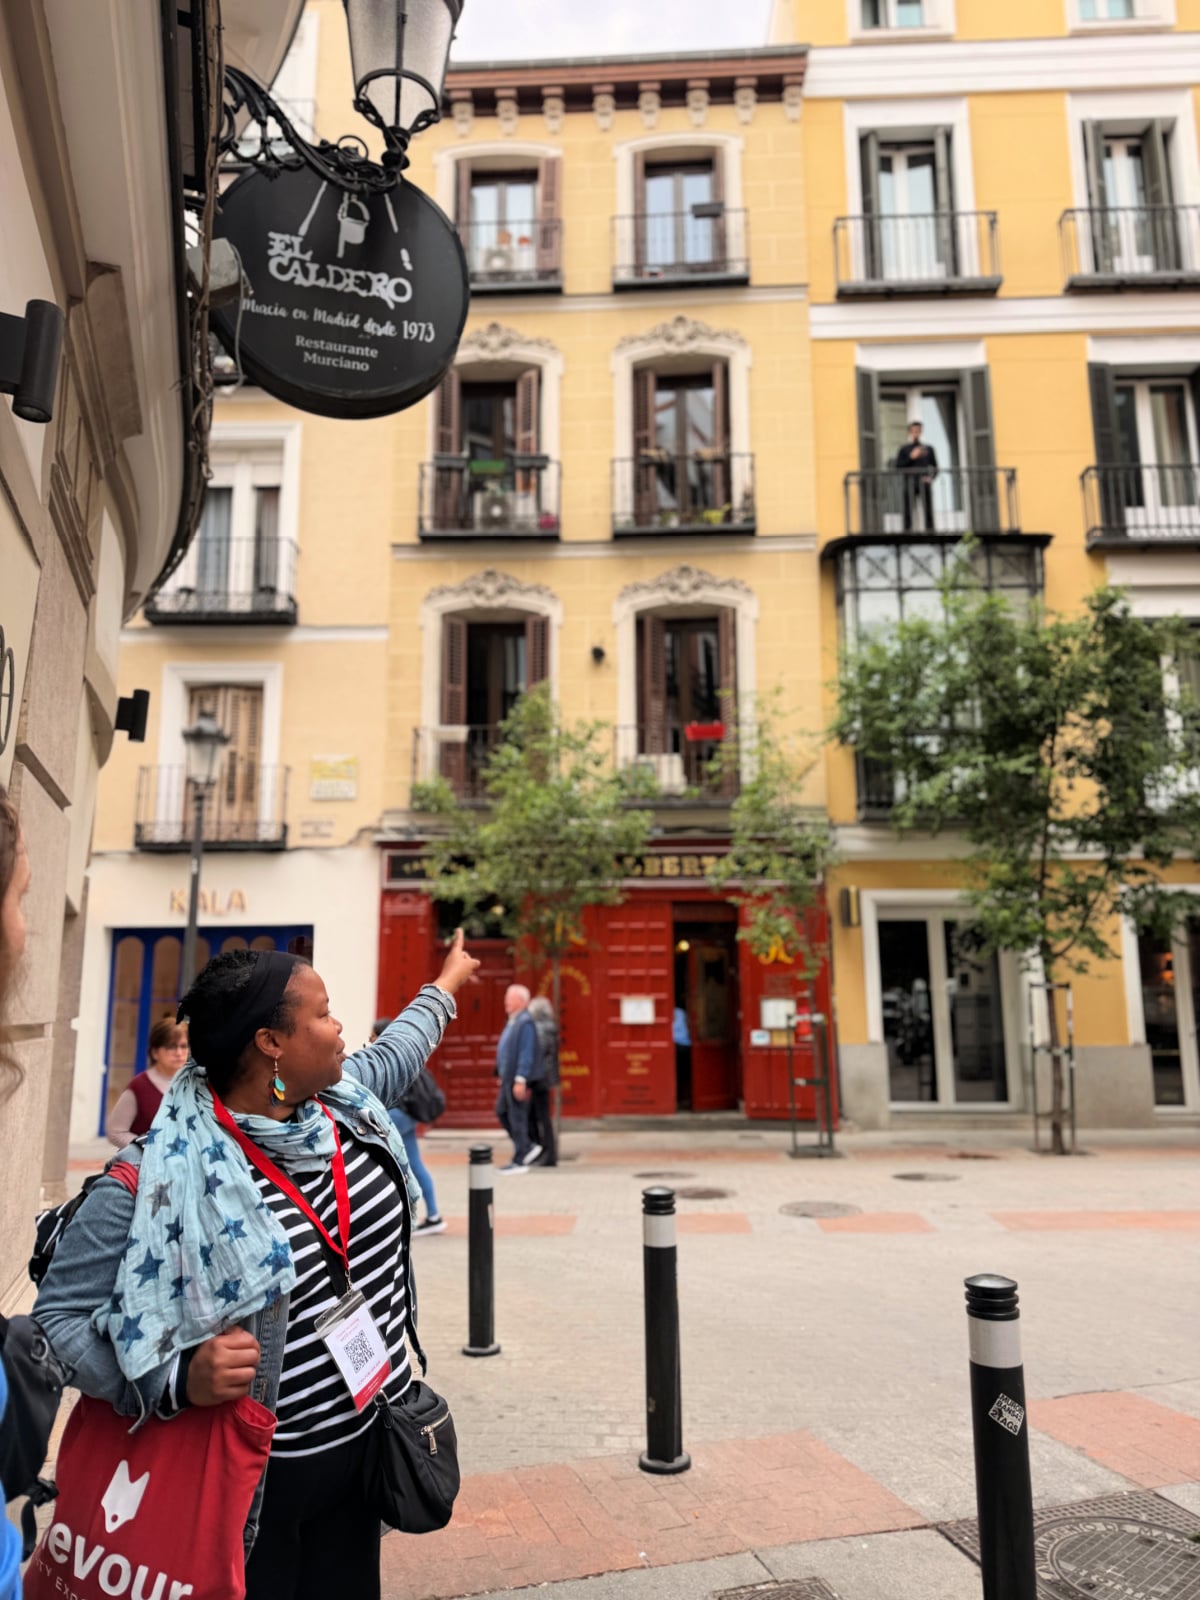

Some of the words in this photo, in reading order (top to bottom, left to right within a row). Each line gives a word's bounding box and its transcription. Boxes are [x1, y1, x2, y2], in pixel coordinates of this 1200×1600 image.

[267, 231, 313, 262] EL
[267, 255, 413, 310] CALDERO
[241, 298, 288, 318] Murcia
[292, 308, 309, 321] en
[313, 307, 361, 328] Madrid
[363, 317, 398, 337] desde
[402, 320, 435, 342] 1973
[295, 334, 379, 359] Restaurante
[303, 351, 370, 372] Murciano
[42, 1522, 194, 1600] evour
